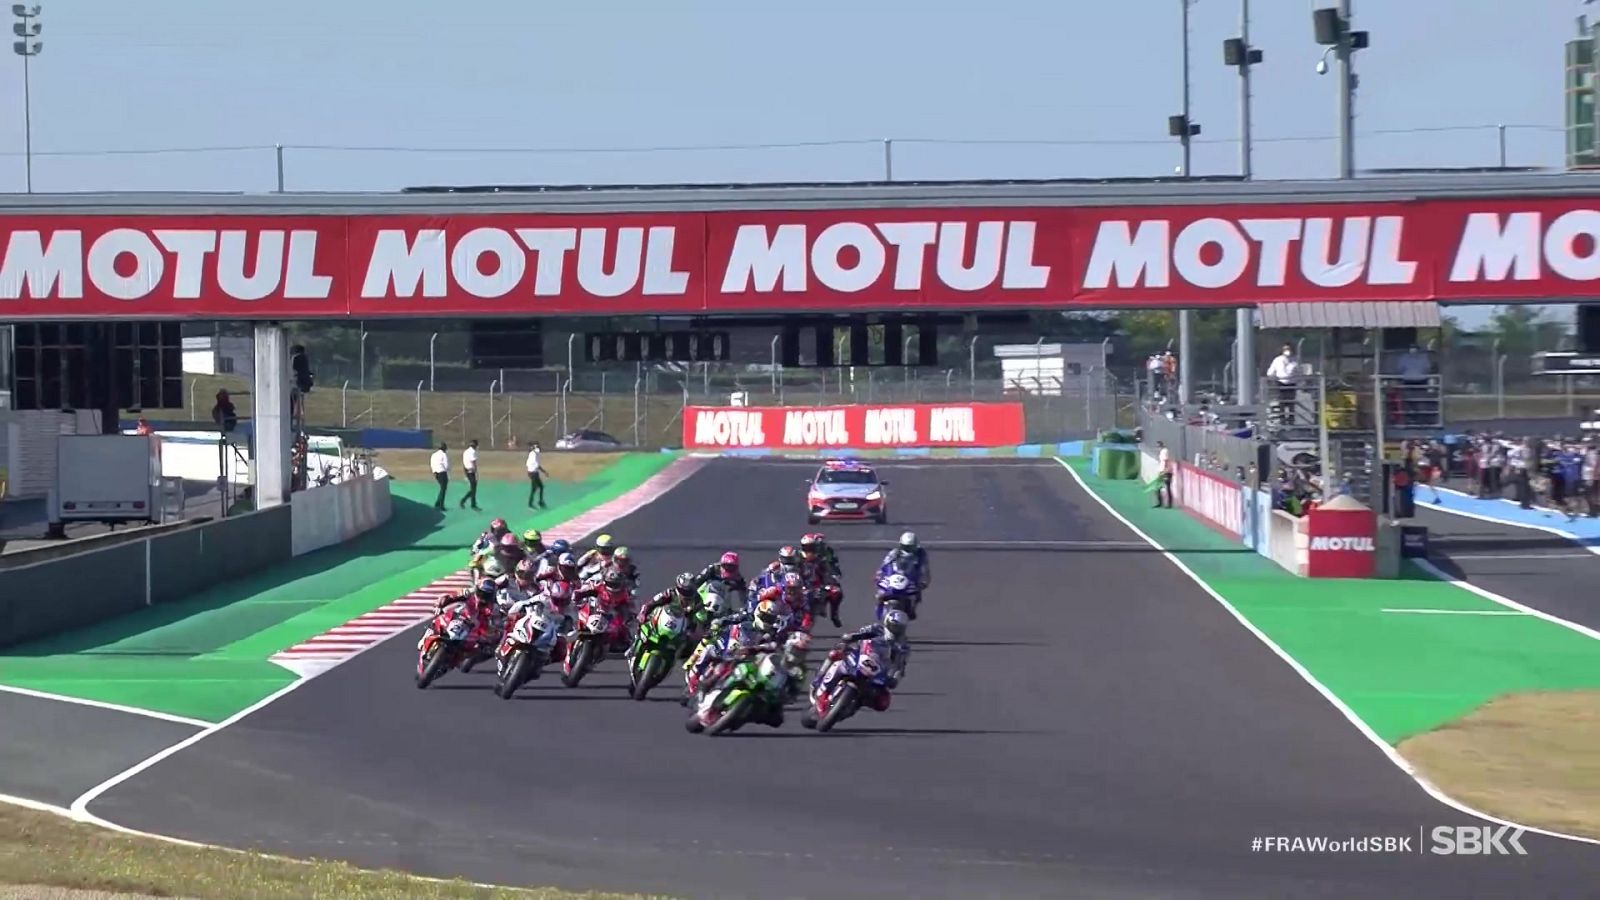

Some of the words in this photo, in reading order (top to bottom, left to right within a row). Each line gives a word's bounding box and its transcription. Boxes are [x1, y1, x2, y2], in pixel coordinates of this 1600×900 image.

[0, 228, 333, 300] MOTUL
[361, 227, 690, 298] MOTUL
[721, 221, 1051, 293] MOTUL
[1083, 215, 1418, 288] MOTUL
[695, 410, 765, 446] MOTUL
[784, 409, 849, 445] MOTUL
[865, 408, 918, 444] MOTUL
[930, 407, 975, 442] MOTUL
[1310, 536, 1376, 552] MOTUL
